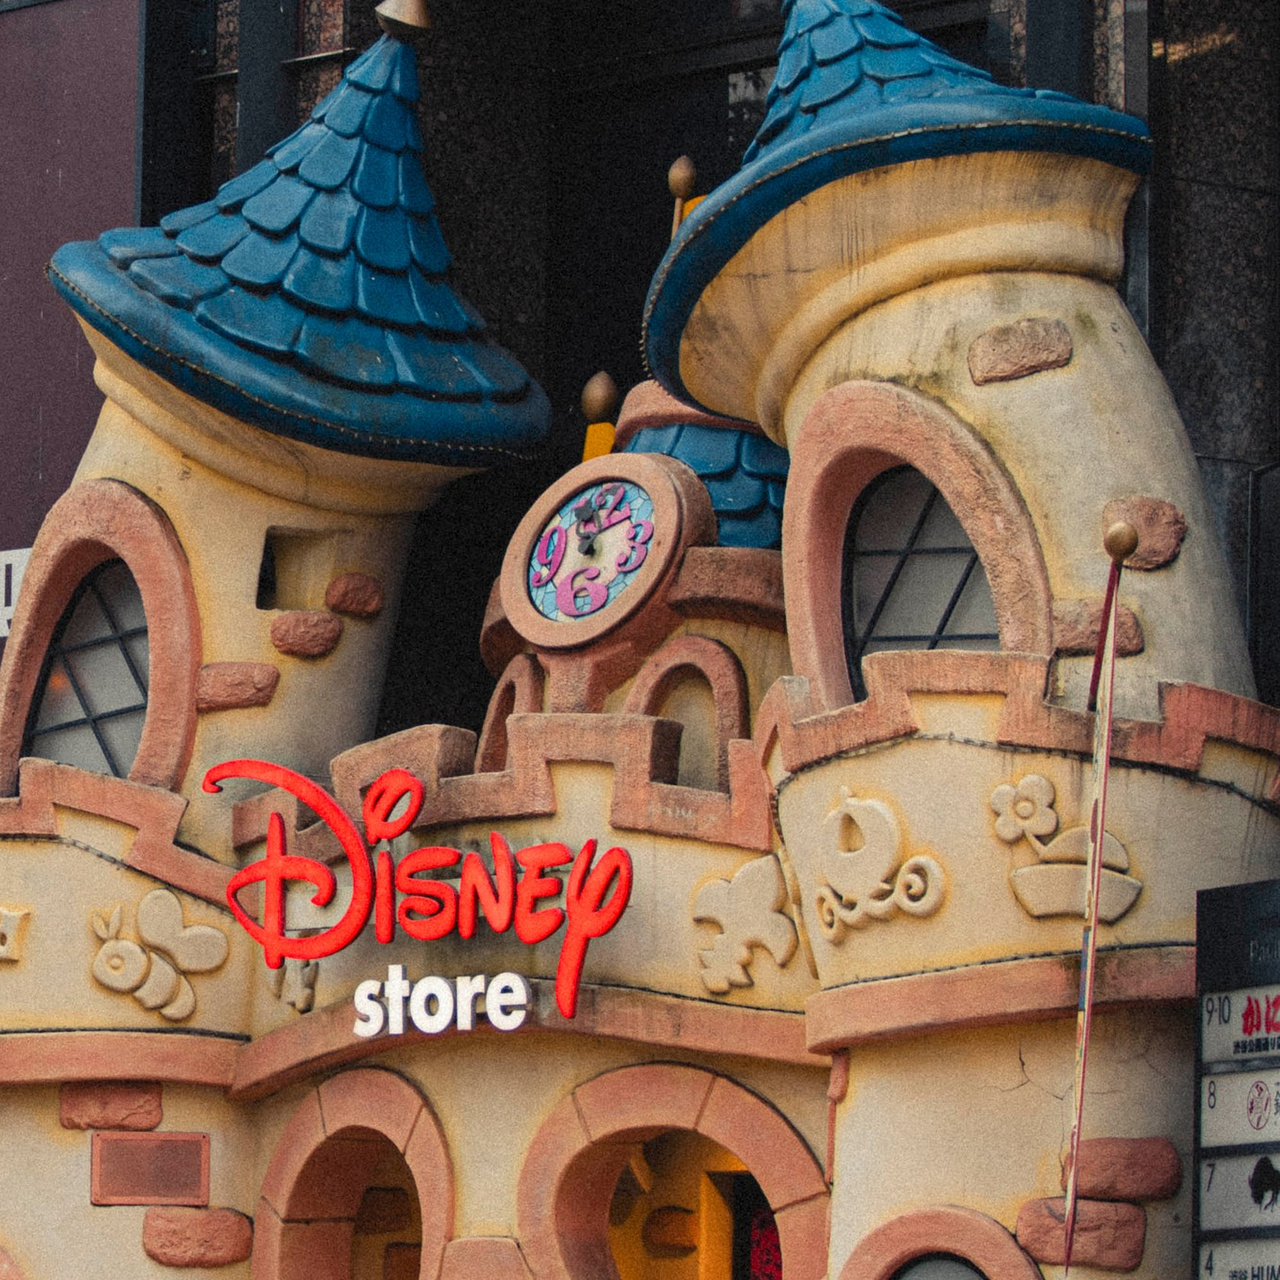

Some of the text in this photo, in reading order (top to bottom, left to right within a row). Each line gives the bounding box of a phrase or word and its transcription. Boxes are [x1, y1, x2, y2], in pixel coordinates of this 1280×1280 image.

[531, 525, 568, 588] 9
[616, 519, 655, 573] 3
[555, 566, 609, 618] 6
[353, 963, 531, 1038] store
[1207, 1080, 1217, 1110] 8
[1206, 1162, 1216, 1193] 7
[1204, 1249, 1214, 1277] 4
